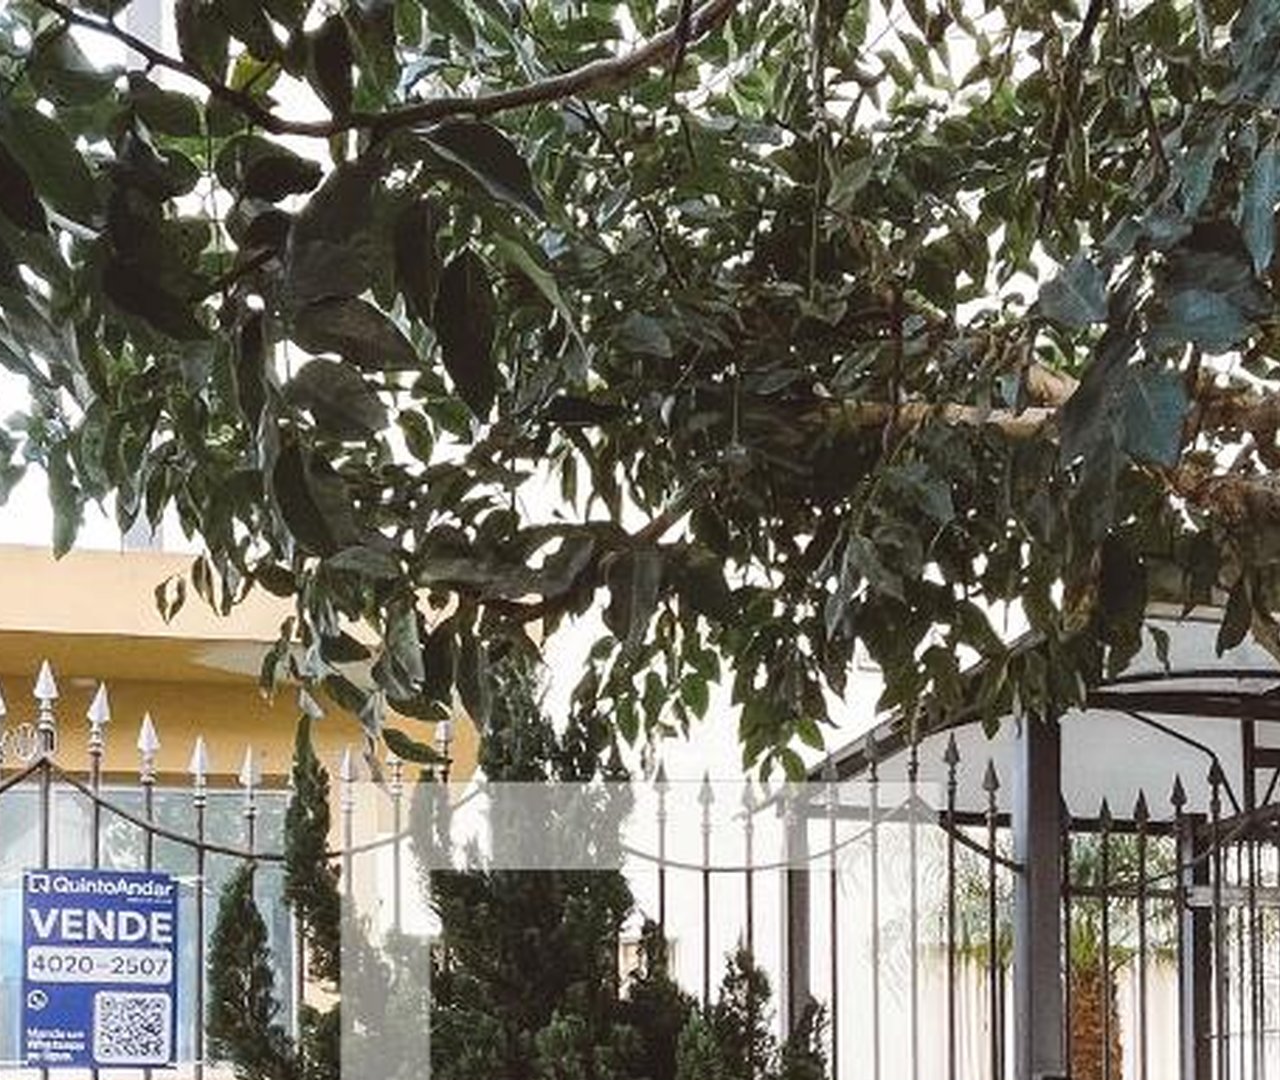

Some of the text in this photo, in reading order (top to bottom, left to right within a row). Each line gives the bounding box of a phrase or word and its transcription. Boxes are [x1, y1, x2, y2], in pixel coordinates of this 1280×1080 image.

[52, 876, 173, 896] QuintoAndar
[29, 908, 173, 943] VENDE
[32, 955, 168, 976] 4020-2507
